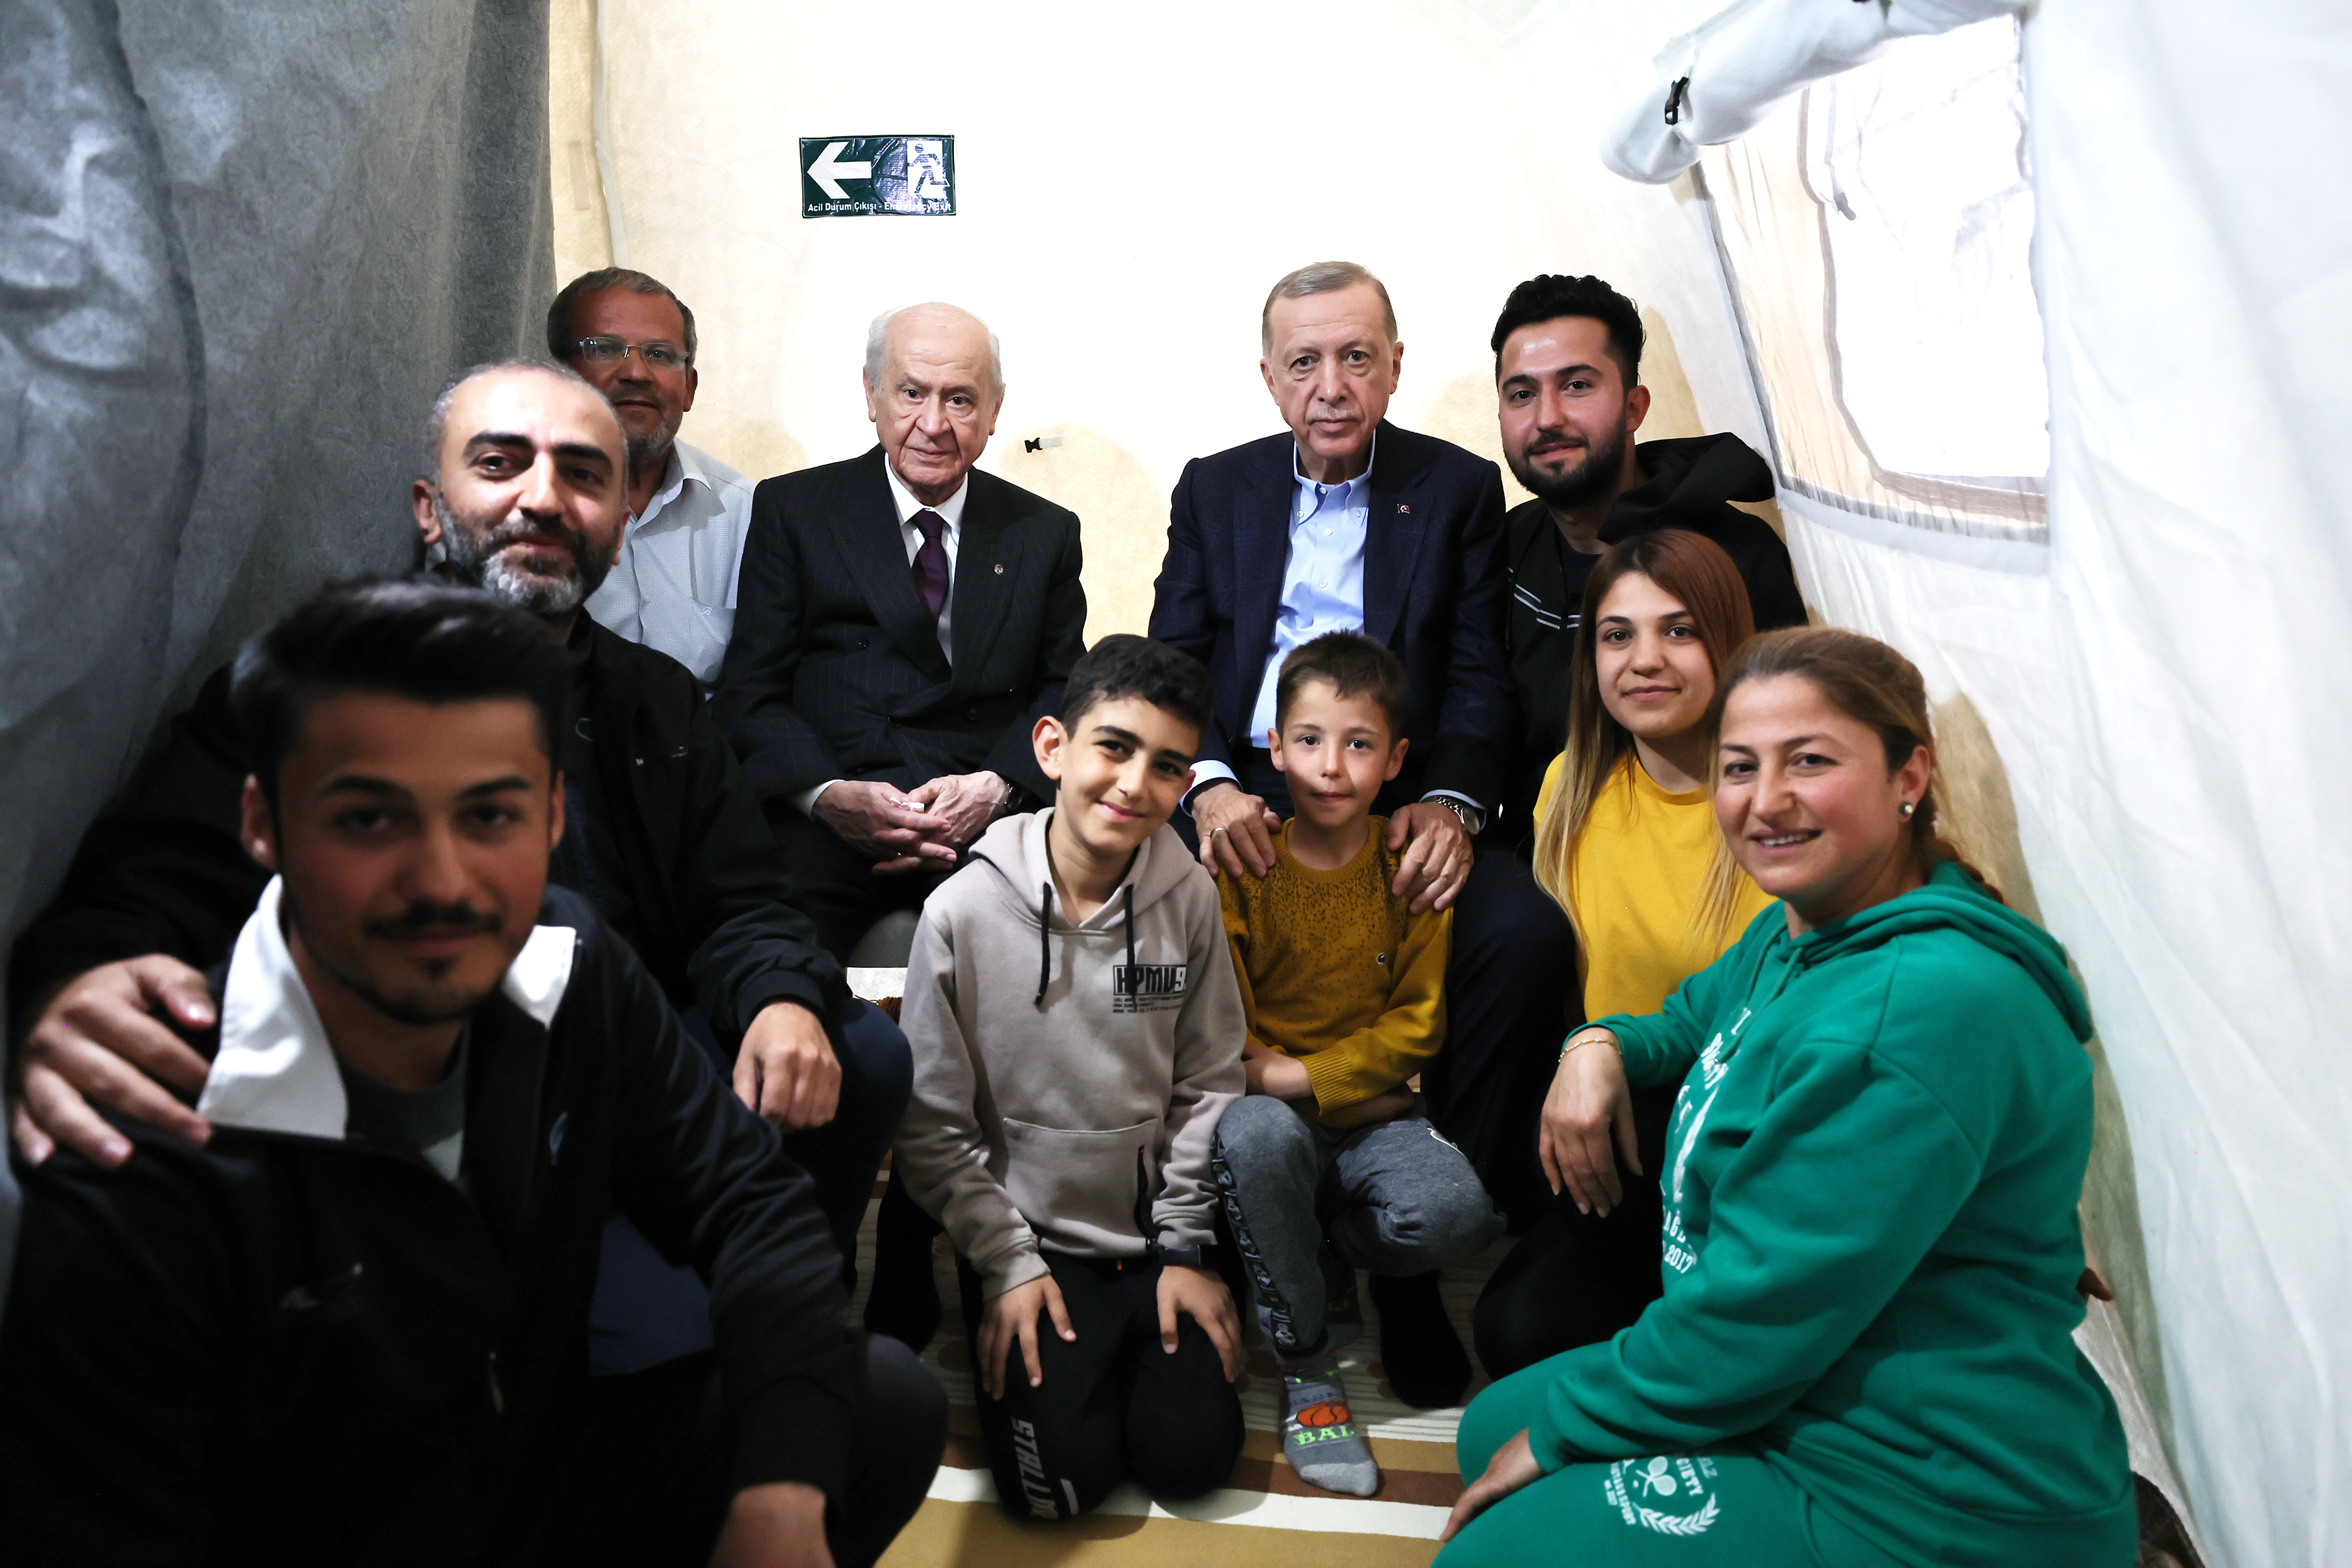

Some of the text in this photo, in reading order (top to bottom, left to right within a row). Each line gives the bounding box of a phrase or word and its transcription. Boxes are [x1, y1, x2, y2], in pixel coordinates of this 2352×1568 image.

[807, 203, 823, 211] Acil
[825, 201, 852, 211] Durum
[854, 201, 877, 213] Çıkışı
